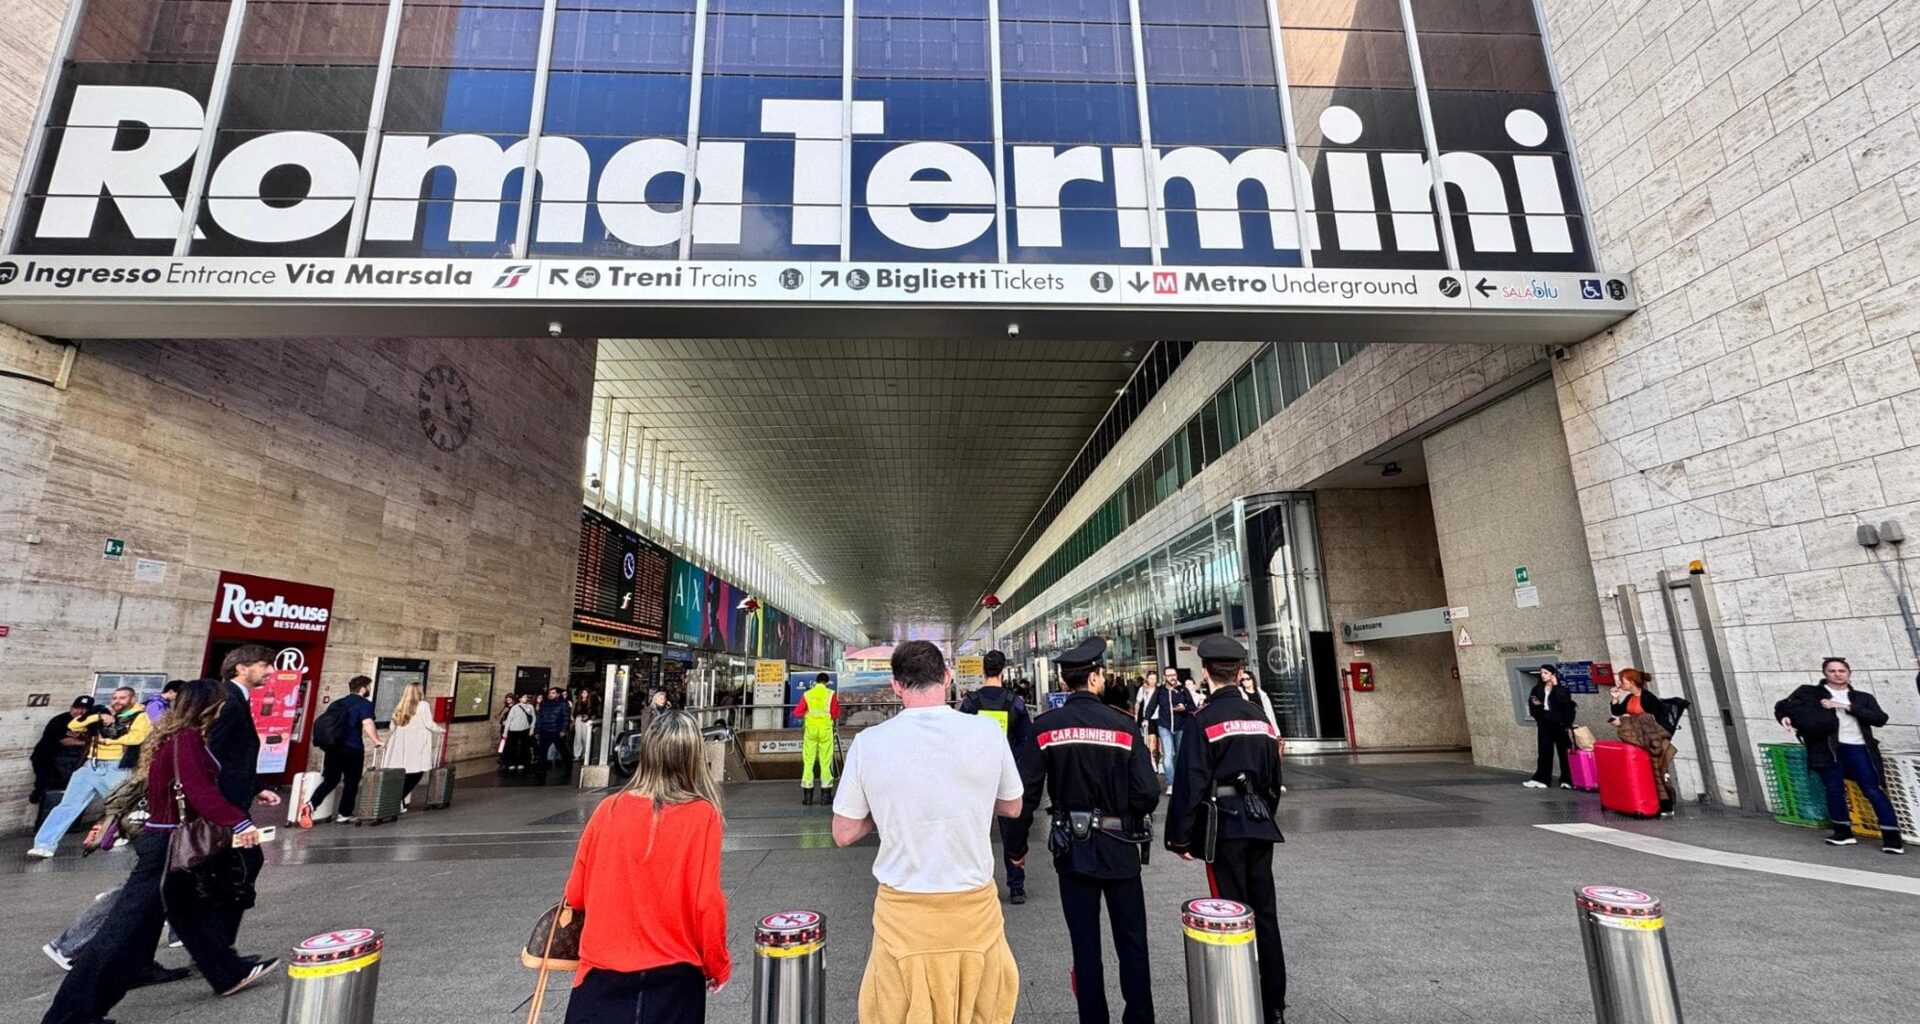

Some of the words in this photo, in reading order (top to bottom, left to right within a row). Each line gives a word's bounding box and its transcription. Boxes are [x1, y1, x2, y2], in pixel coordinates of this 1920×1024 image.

[761, 98, 1574, 253] Termini
[25, 261, 161, 289] Ingresso
[167, 262, 277, 285] Entrance
[286, 263, 333, 285] Via
[345, 263, 473, 286] Marsala
[608, 265, 682, 288] Treni
[688, 266, 757, 289] Trains
[876, 267, 986, 293] Biglietti
[991, 269, 1065, 291] Tickets
[1184, 271, 1267, 293] Metro
[1272, 272, 1418, 299] Underground
[216, 583, 329, 629] Roadhouse
[273, 620, 327, 632] RESTAURANT
[1051, 728, 1117, 743] CARABINIERI
